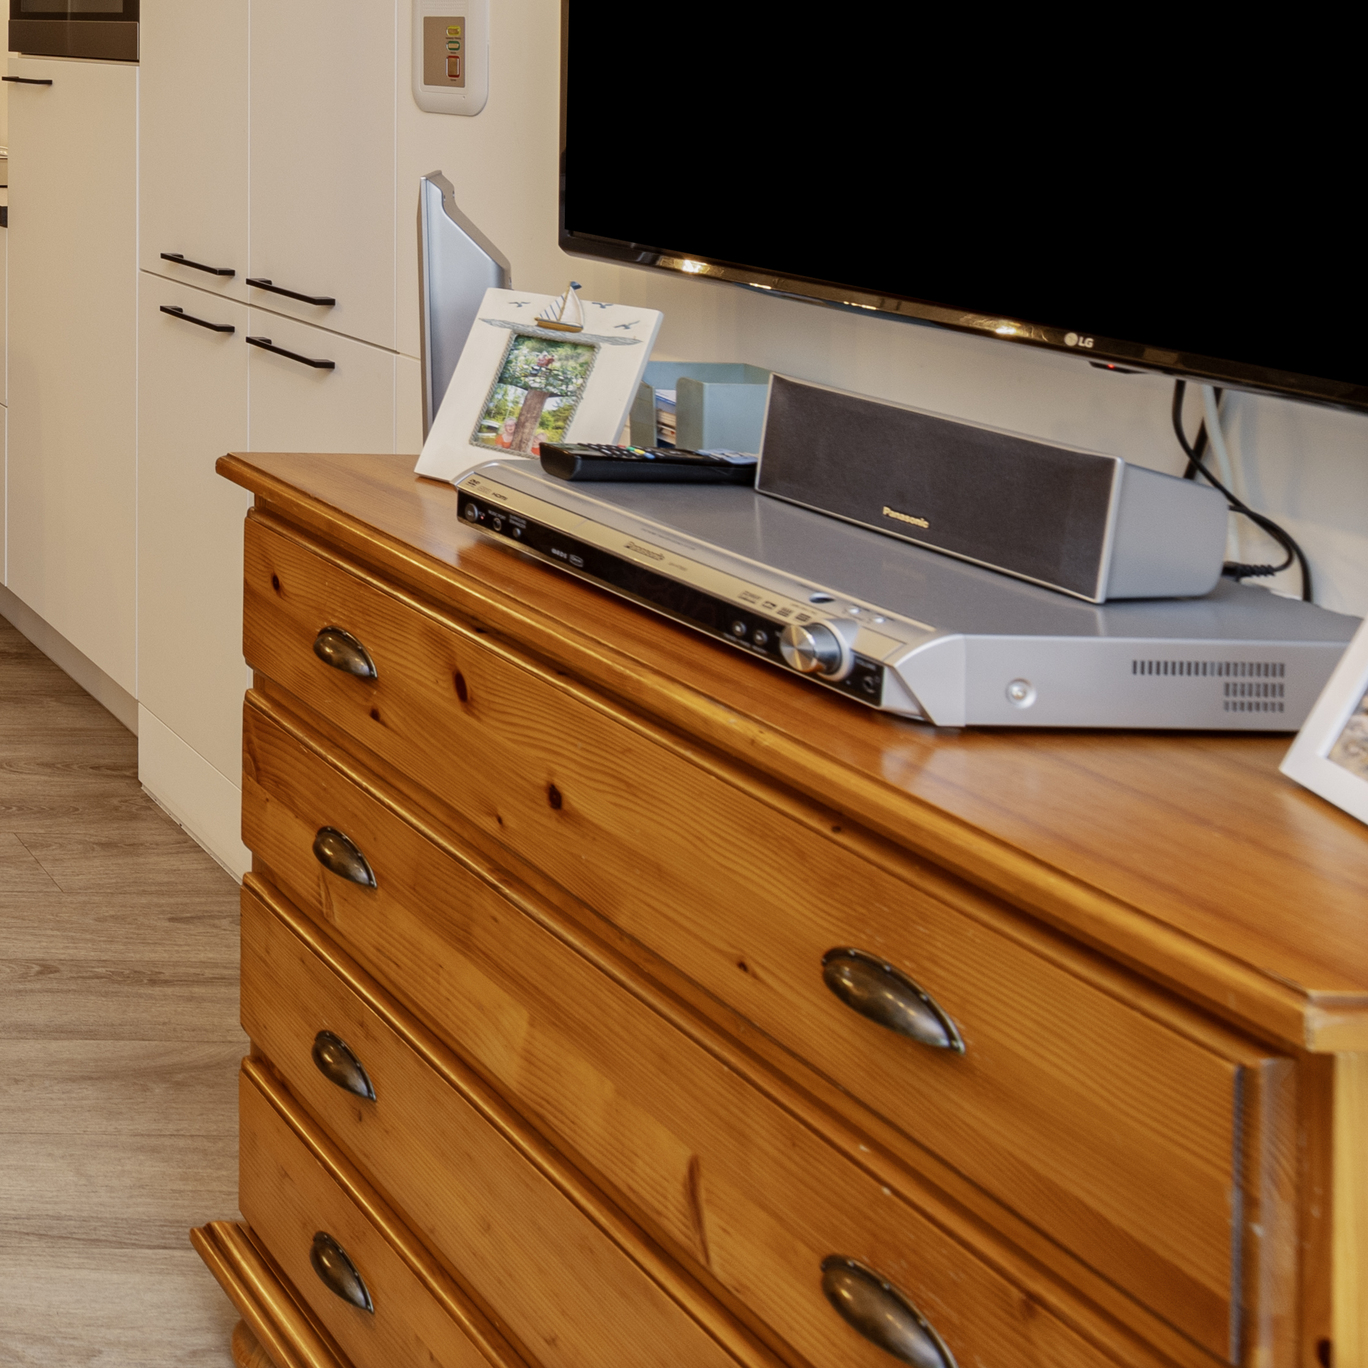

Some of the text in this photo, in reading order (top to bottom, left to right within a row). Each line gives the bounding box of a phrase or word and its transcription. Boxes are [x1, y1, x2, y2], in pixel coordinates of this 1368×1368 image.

[1078, 336, 1094, 348] LG
[882, 505, 930, 529] Panasonic
[624, 541, 665, 561] Panasonic
